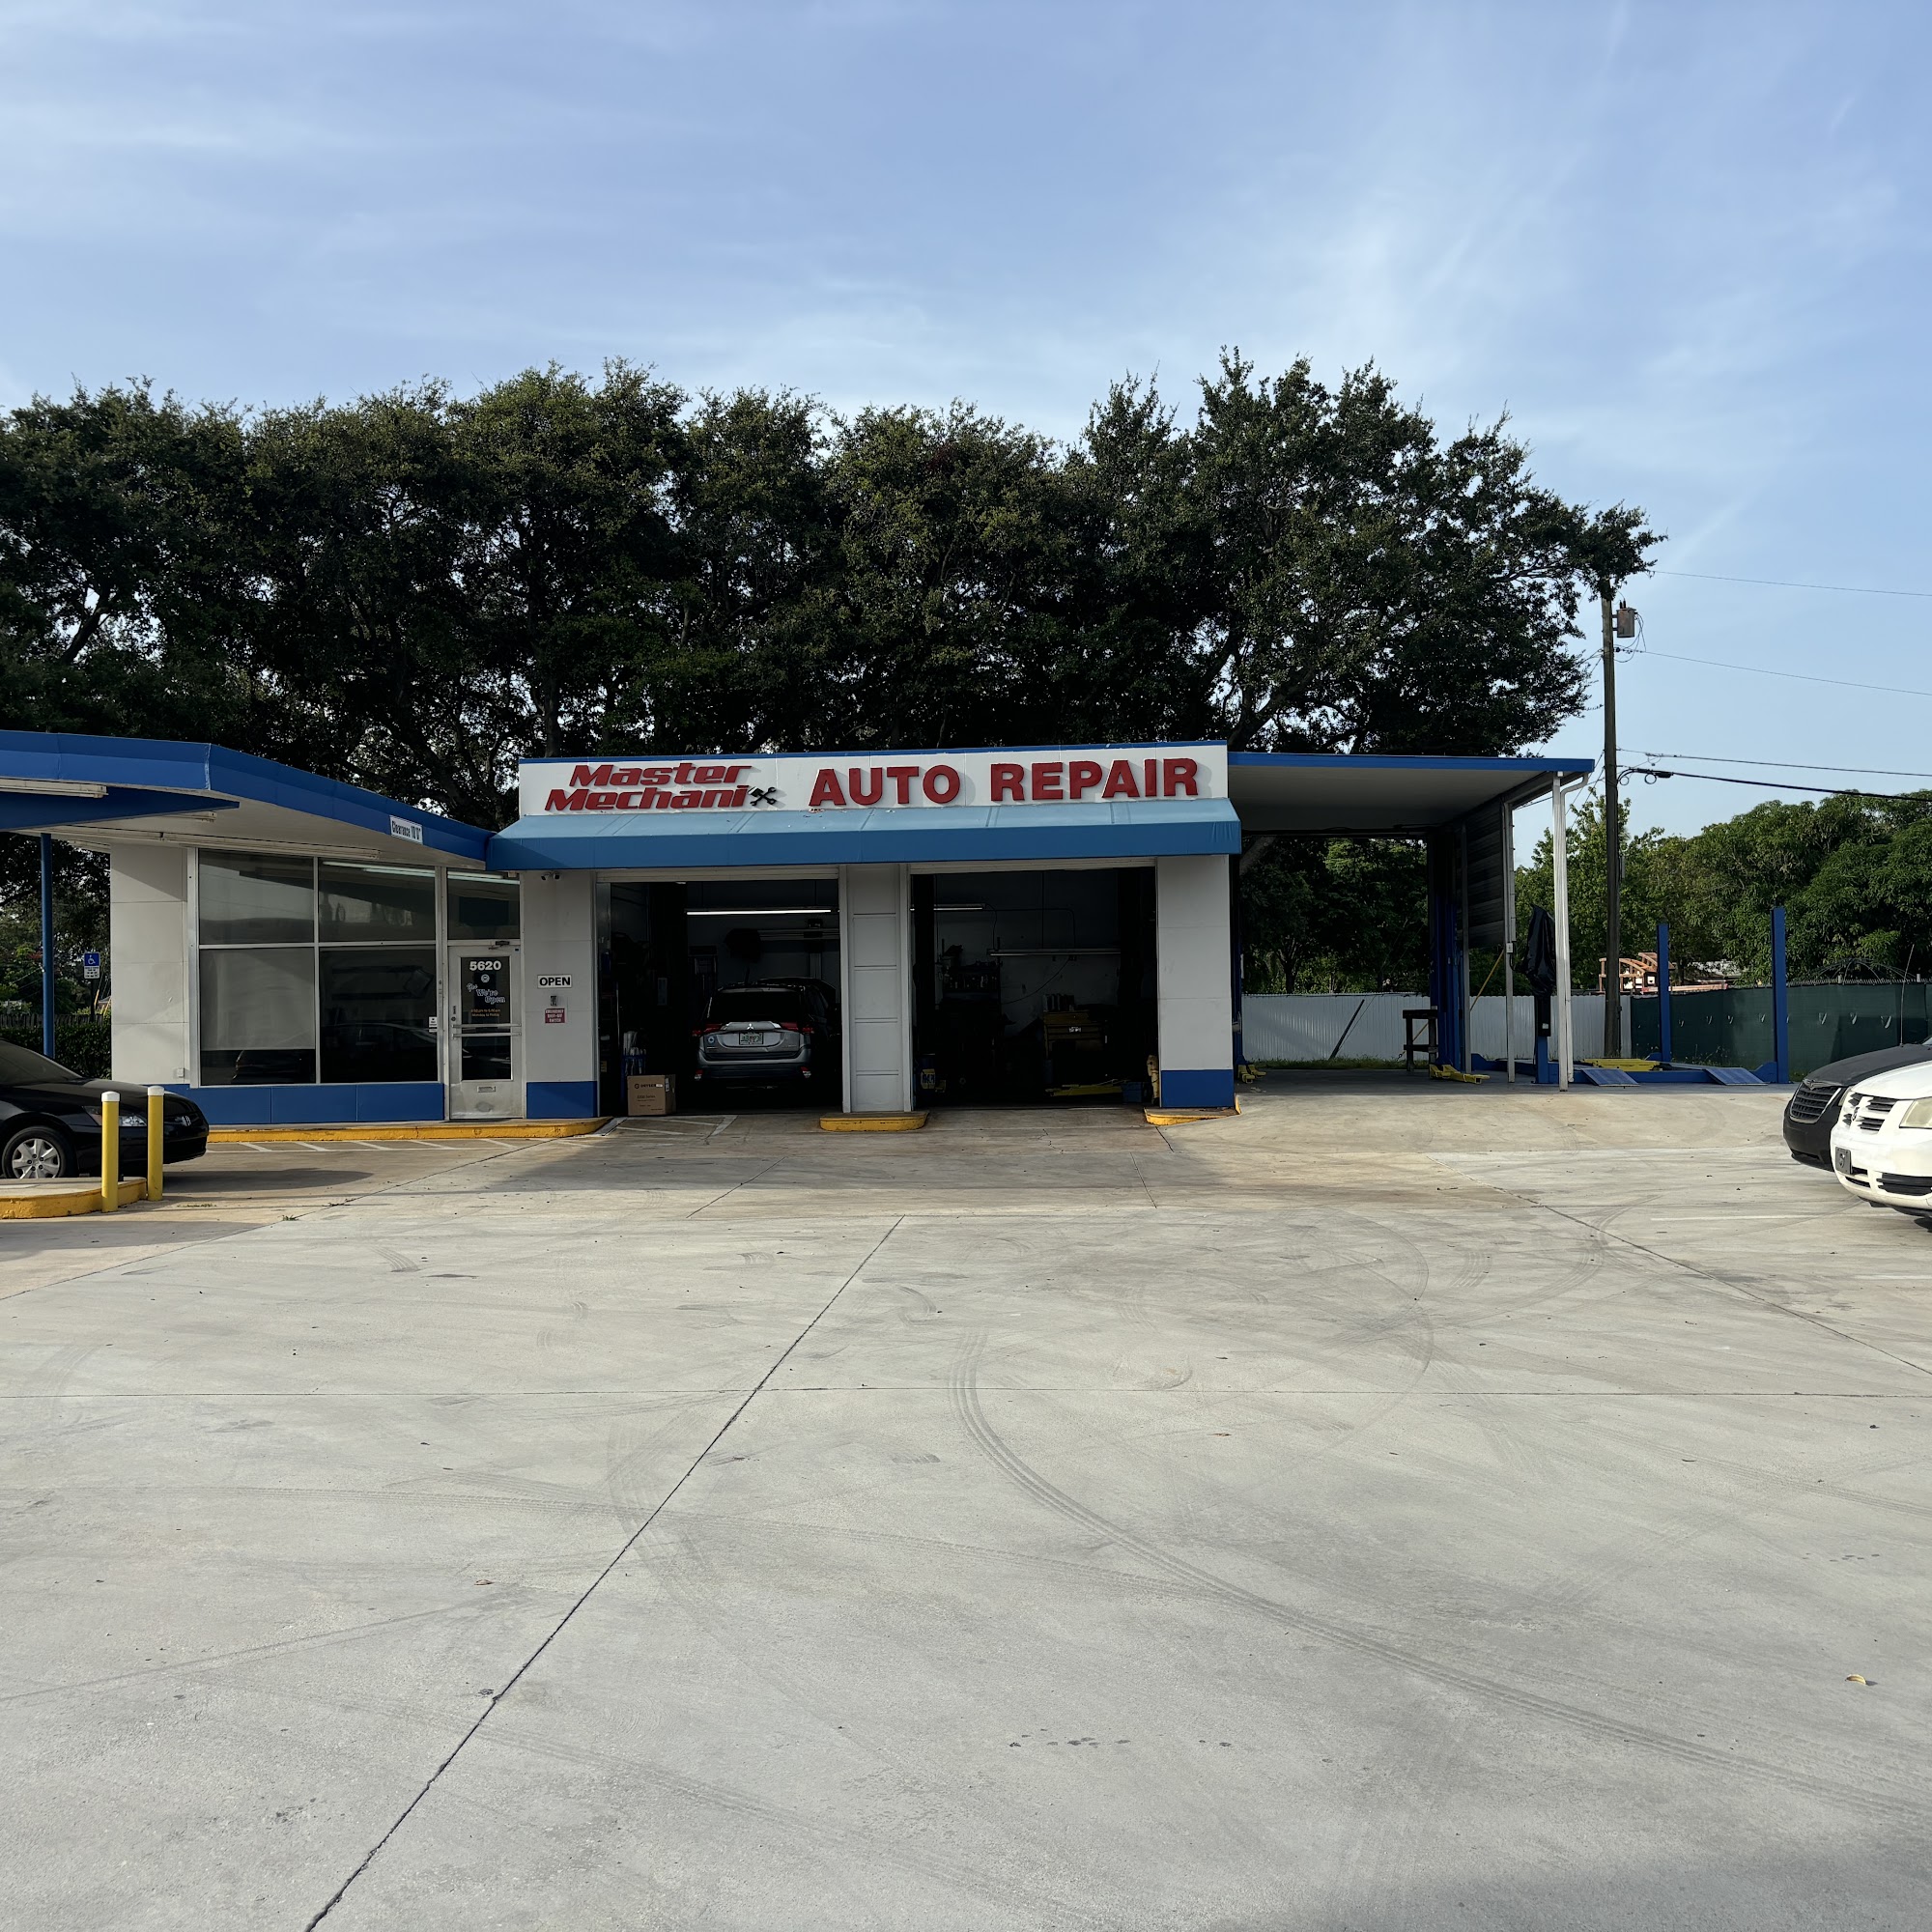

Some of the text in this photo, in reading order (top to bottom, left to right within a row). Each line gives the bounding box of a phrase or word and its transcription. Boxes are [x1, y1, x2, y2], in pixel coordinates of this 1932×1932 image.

[569, 762, 752, 787] Master
[809, 757, 1199, 807] AUTO REPAIR
[391, 820, 411, 838] Clearance
[469, 960, 501, 971] 5620
[539, 977, 571, 986] OPEN
